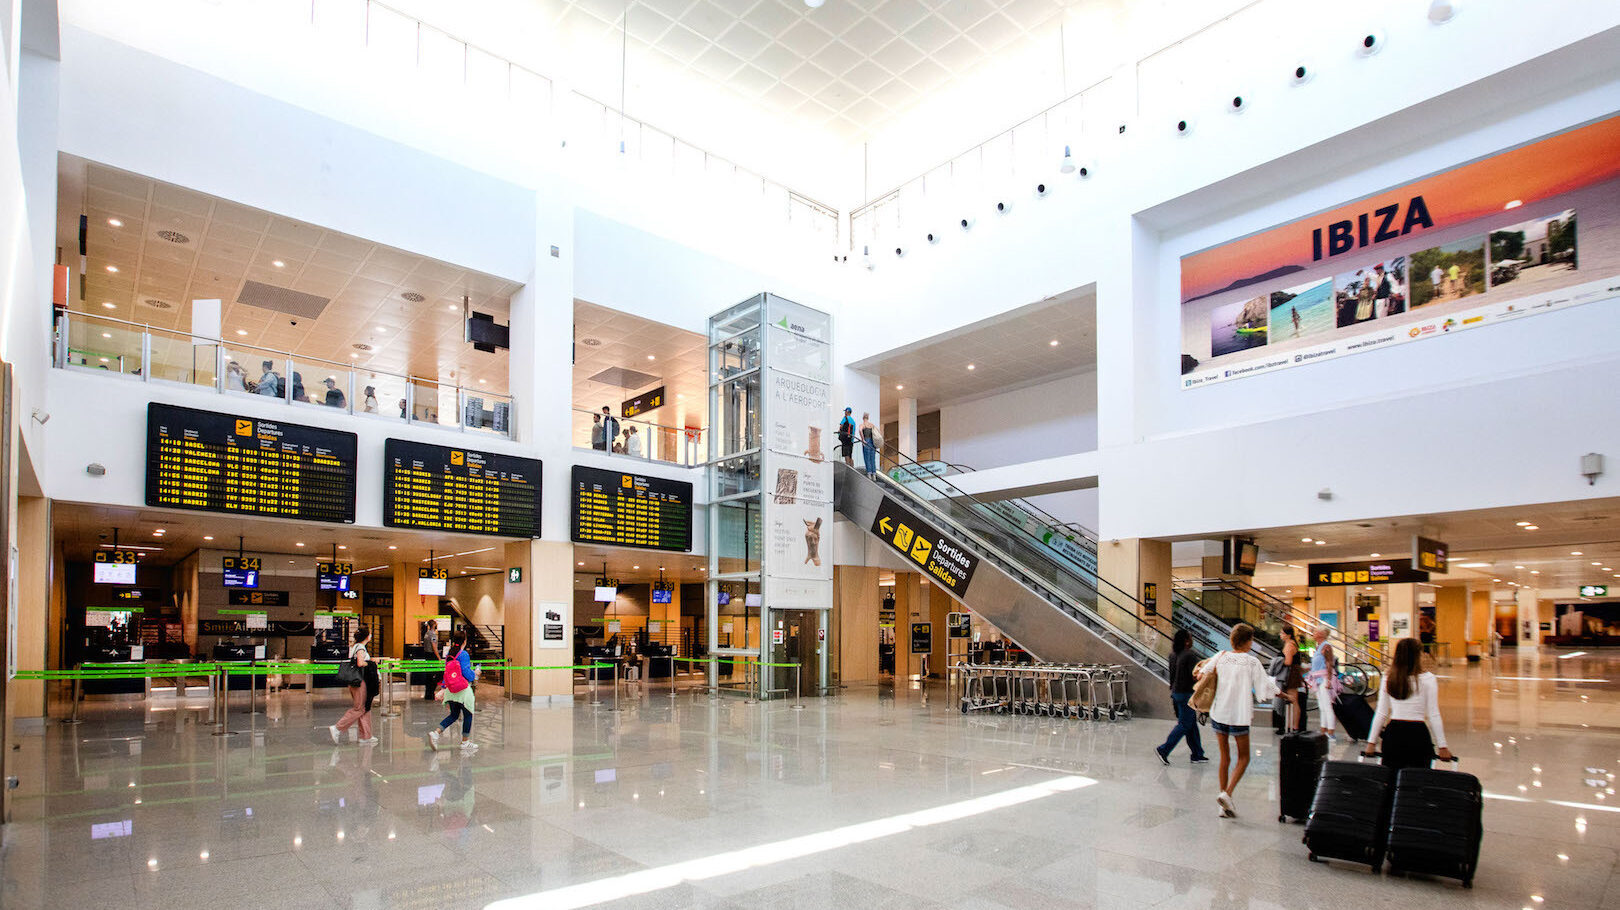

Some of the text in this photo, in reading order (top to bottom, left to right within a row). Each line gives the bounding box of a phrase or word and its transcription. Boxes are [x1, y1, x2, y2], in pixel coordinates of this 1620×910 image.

[1313, 195, 1434, 261] IBIZA
[791, 324, 805, 333] aena
[776, 377, 826, 398] ARQUEOLOGIA
[257, 422, 278, 430] Sortides
[258, 428, 283, 436] Departures
[160, 446, 180, 454] 14:20
[184, 449, 216, 458] VALENCIA
[160, 454, 180, 462] 14:40
[183, 457, 219, 467] BARCELONA
[159, 463, 180, 471] 14:40
[183, 466, 219, 475] BARCELONA
[183, 474, 207, 482] MADRID
[183, 482, 207, 490] MADRID
[183, 490, 207, 498] MADRID
[183, 498, 207, 506] MADRID
[114, 551, 136, 564] 33
[937, 539, 970, 568] Sortides
[240, 557, 259, 570] 34
[334, 563, 352, 575] 35
[933, 550, 967, 580] Departures
[432, 568, 448, 580] 36
[928, 561, 956, 587] Salidas
[606, 579, 619, 587] 38
